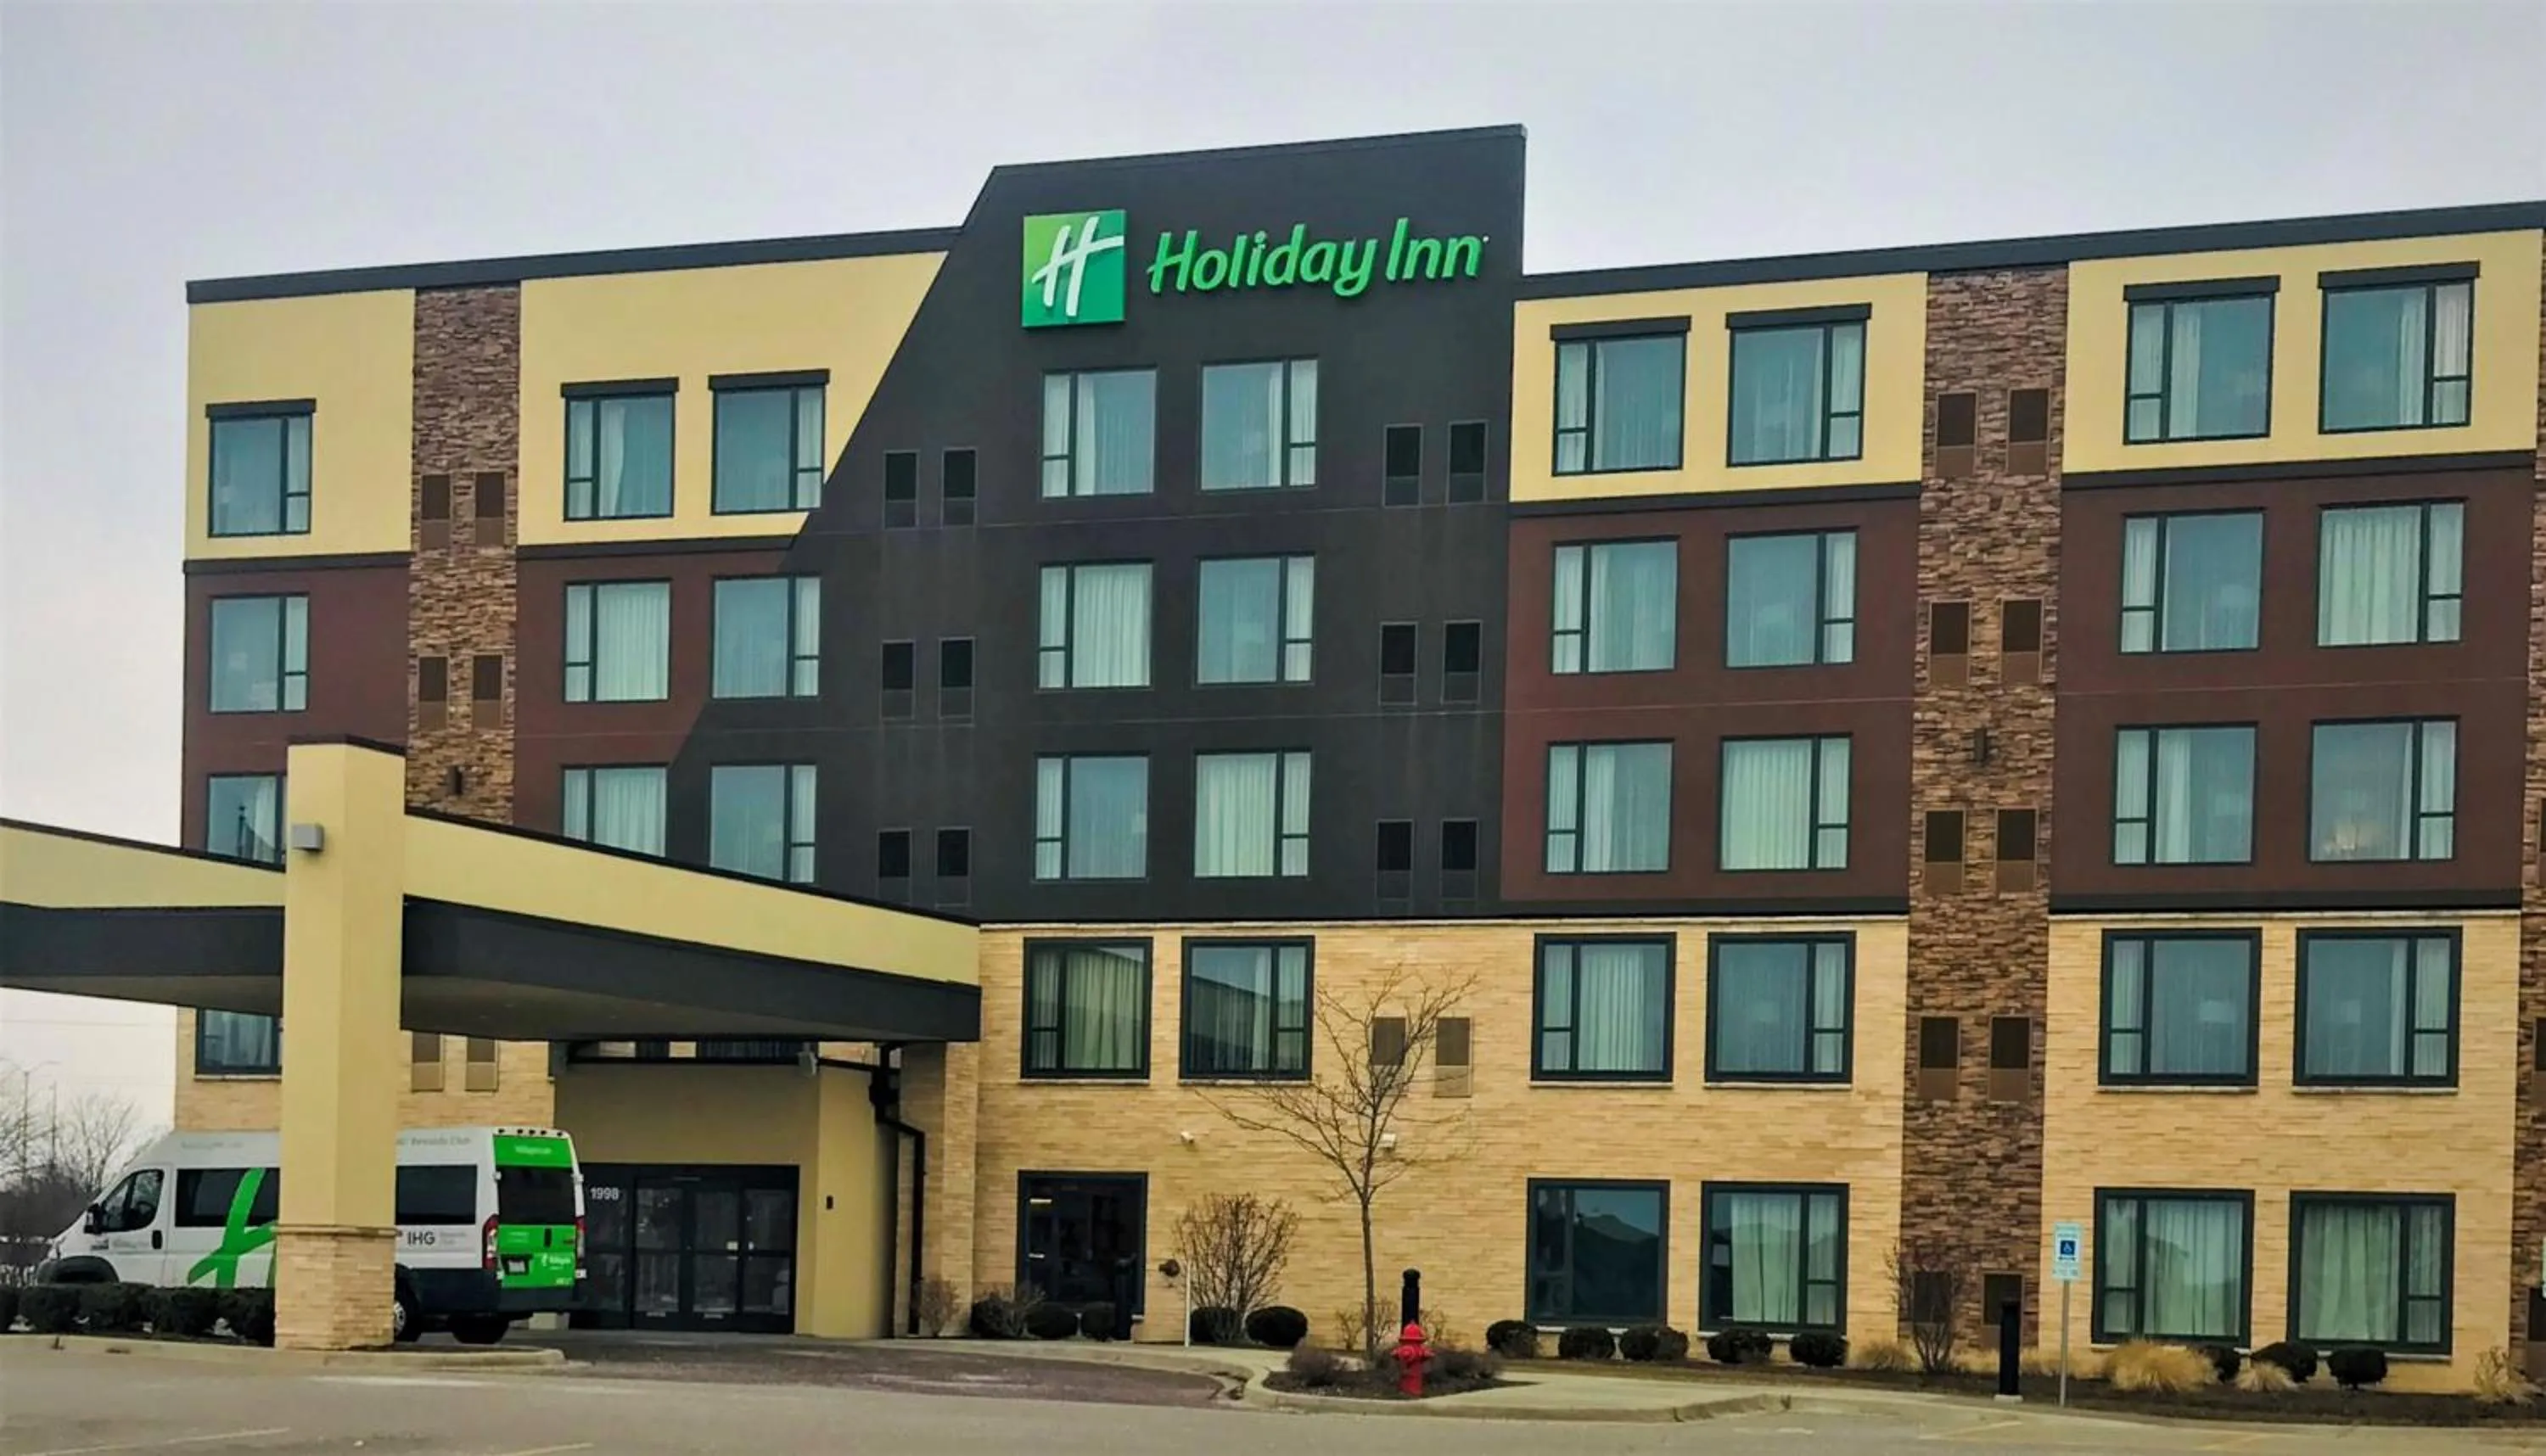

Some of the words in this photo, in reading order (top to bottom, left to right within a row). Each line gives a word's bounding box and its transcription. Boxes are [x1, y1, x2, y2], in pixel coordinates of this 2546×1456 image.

[1147, 223, 1377, 297] Holiday
[1386, 217, 1482, 281] Inn
[590, 1187, 620, 1201] 1998
[407, 1230, 435, 1246] IHG
